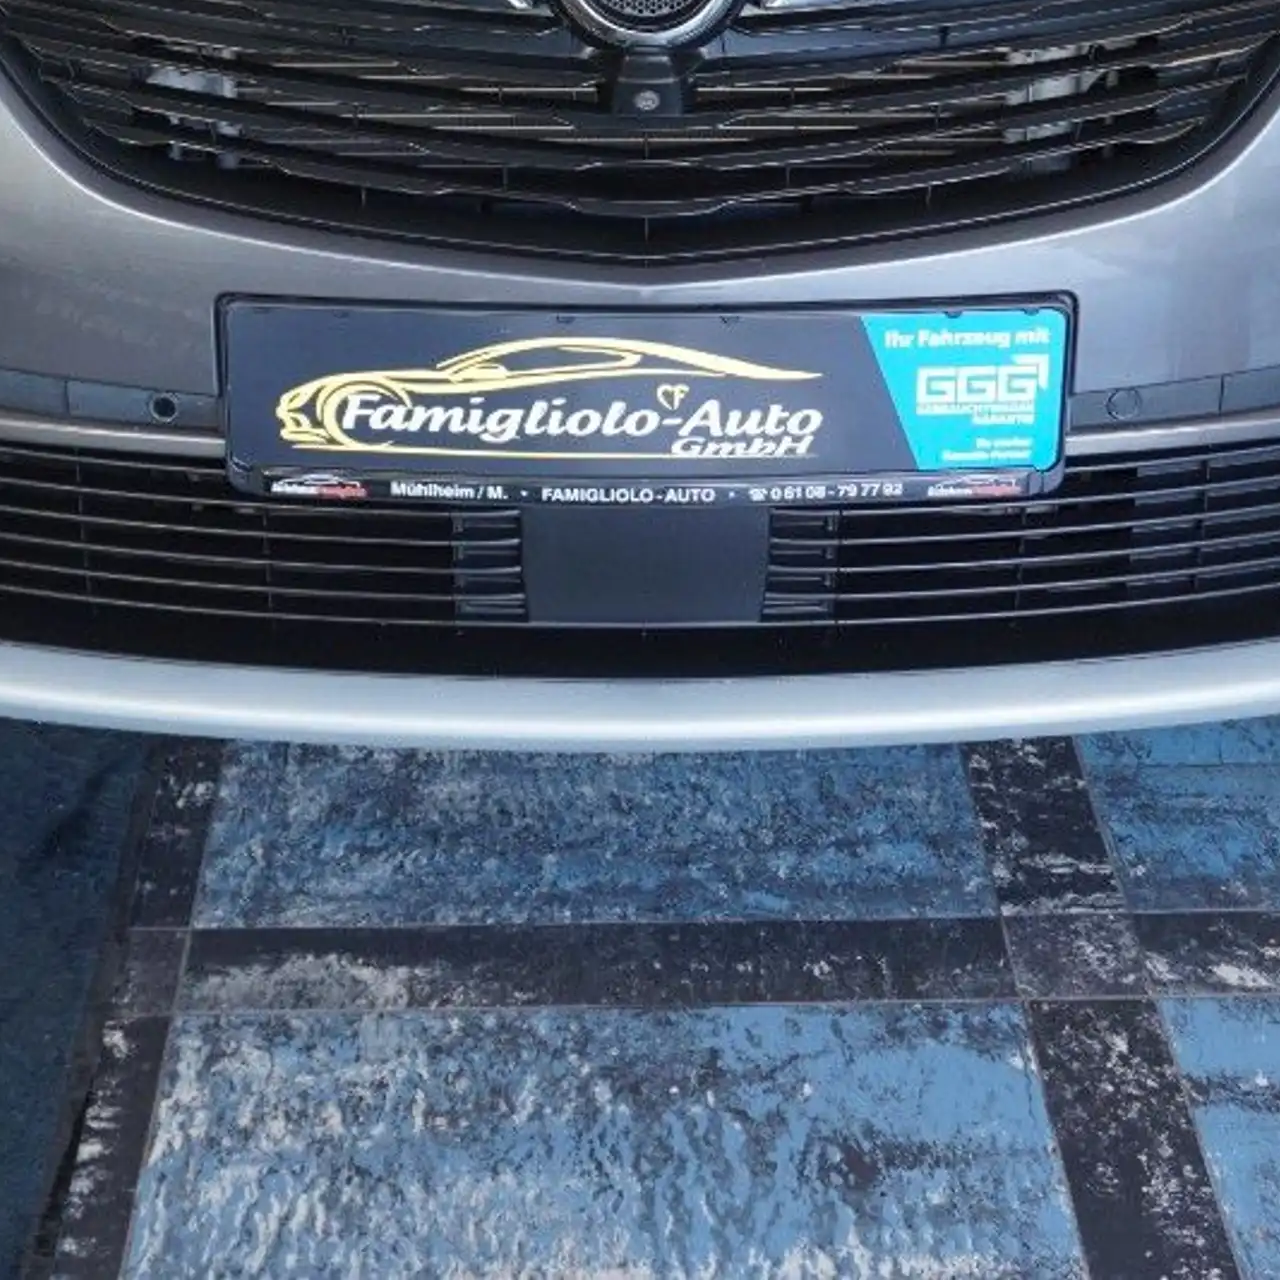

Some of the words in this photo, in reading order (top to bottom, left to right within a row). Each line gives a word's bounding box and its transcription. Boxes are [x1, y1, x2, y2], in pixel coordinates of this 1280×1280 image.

[916, 364, 1039, 404] GGG
[671, 435, 815, 458] GmbH
[390, 480, 475, 499] Mühlheim
